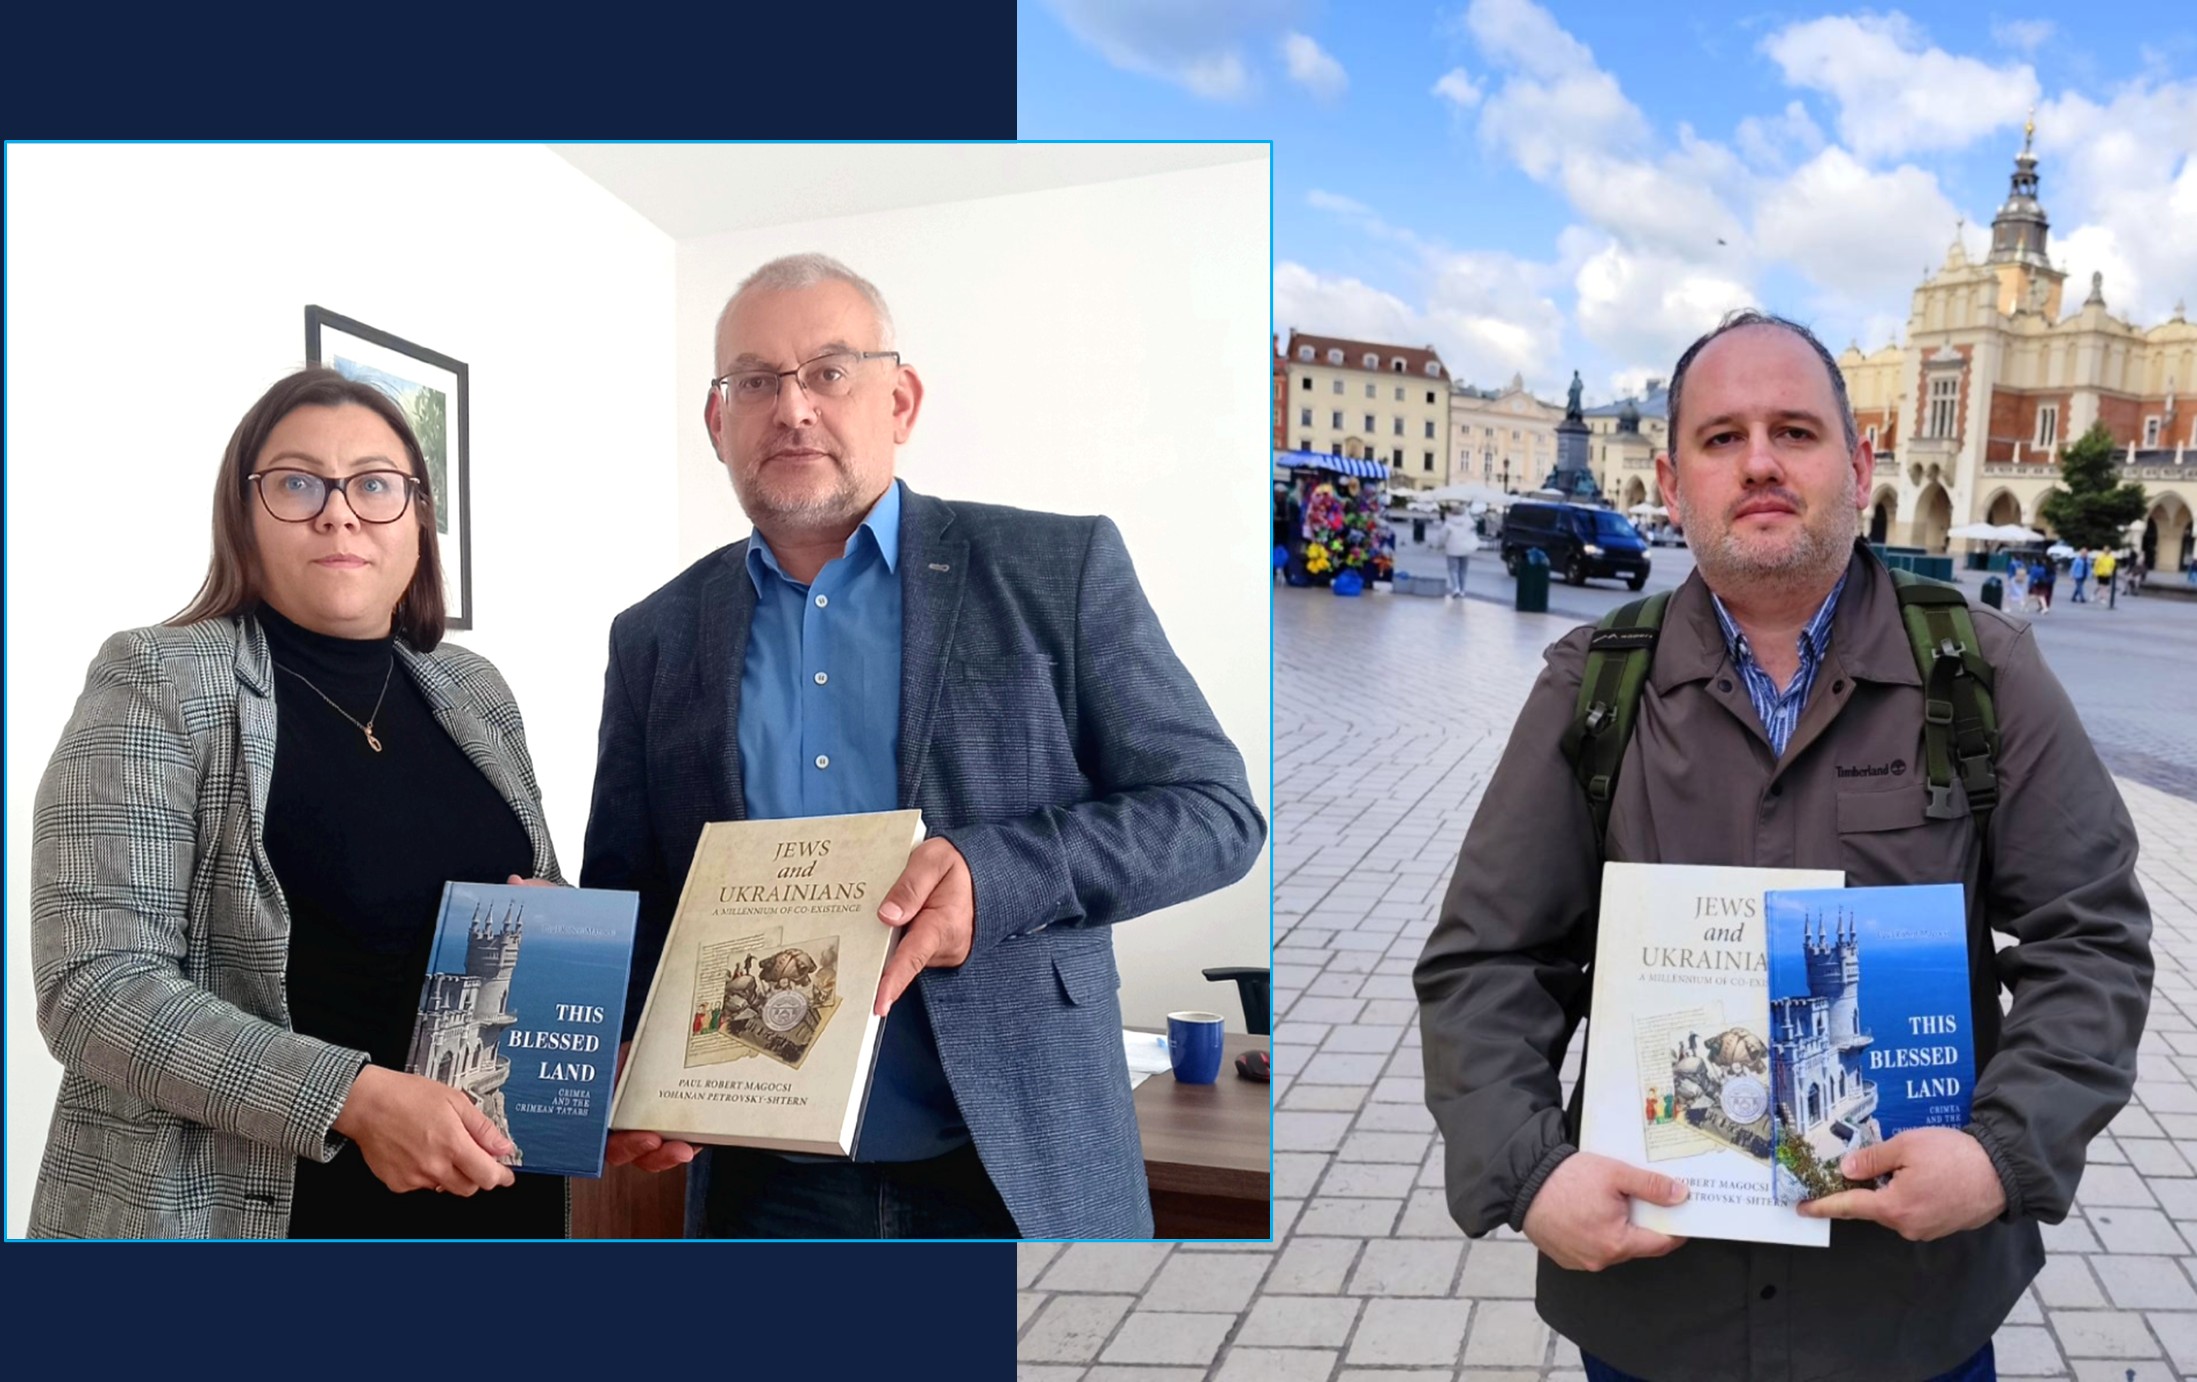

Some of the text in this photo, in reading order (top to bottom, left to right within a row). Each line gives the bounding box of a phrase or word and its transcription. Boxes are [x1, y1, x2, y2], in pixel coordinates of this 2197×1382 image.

[1835, 763, 1889, 777] Timberland
[773, 840, 831, 862] JEWS
[777, 860, 817, 878] and
[719, 882, 867, 903] UKRAINIANS
[712, 904, 861, 916] A MILLENNIUM OF CO-EXISTENCE
[1694, 896, 1756, 919] JEWS
[1704, 922, 1745, 942] and
[1642, 947, 1768, 972] UKRAINIA
[1639, 973, 1646, 981] A
[1648, 973, 1712, 985] MILLENNIUM
[1715, 977, 1728, 986] OF
[556, 1003, 604, 1024] THIS
[1908, 1014, 1957, 1035] THIS
[507, 1030, 599, 1053] BLESSED
[1869, 1046, 1958, 1070] BLESSED
[538, 1061, 596, 1082] LAND
[558, 1088, 591, 1099] CRIMEA
[678, 1079, 792, 1093] PAUL ROBERT MAGOCSI
[1906, 1077, 1960, 1099] LAND
[551, 1096, 590, 1107] AND THE
[658, 1090, 808, 1106] YOHANAN PETROVSKY-SHTERN
[515, 1103, 589, 1117] CRIMEAN TATARS
[1929, 1104, 1960, 1114] CRIMEA
[1926, 1113, 1961, 1124] AND THE
[1719, 1180, 1769, 1192] MAGOCSI
[1687, 1191, 1788, 1207] ETROVSKY-SHTERN
